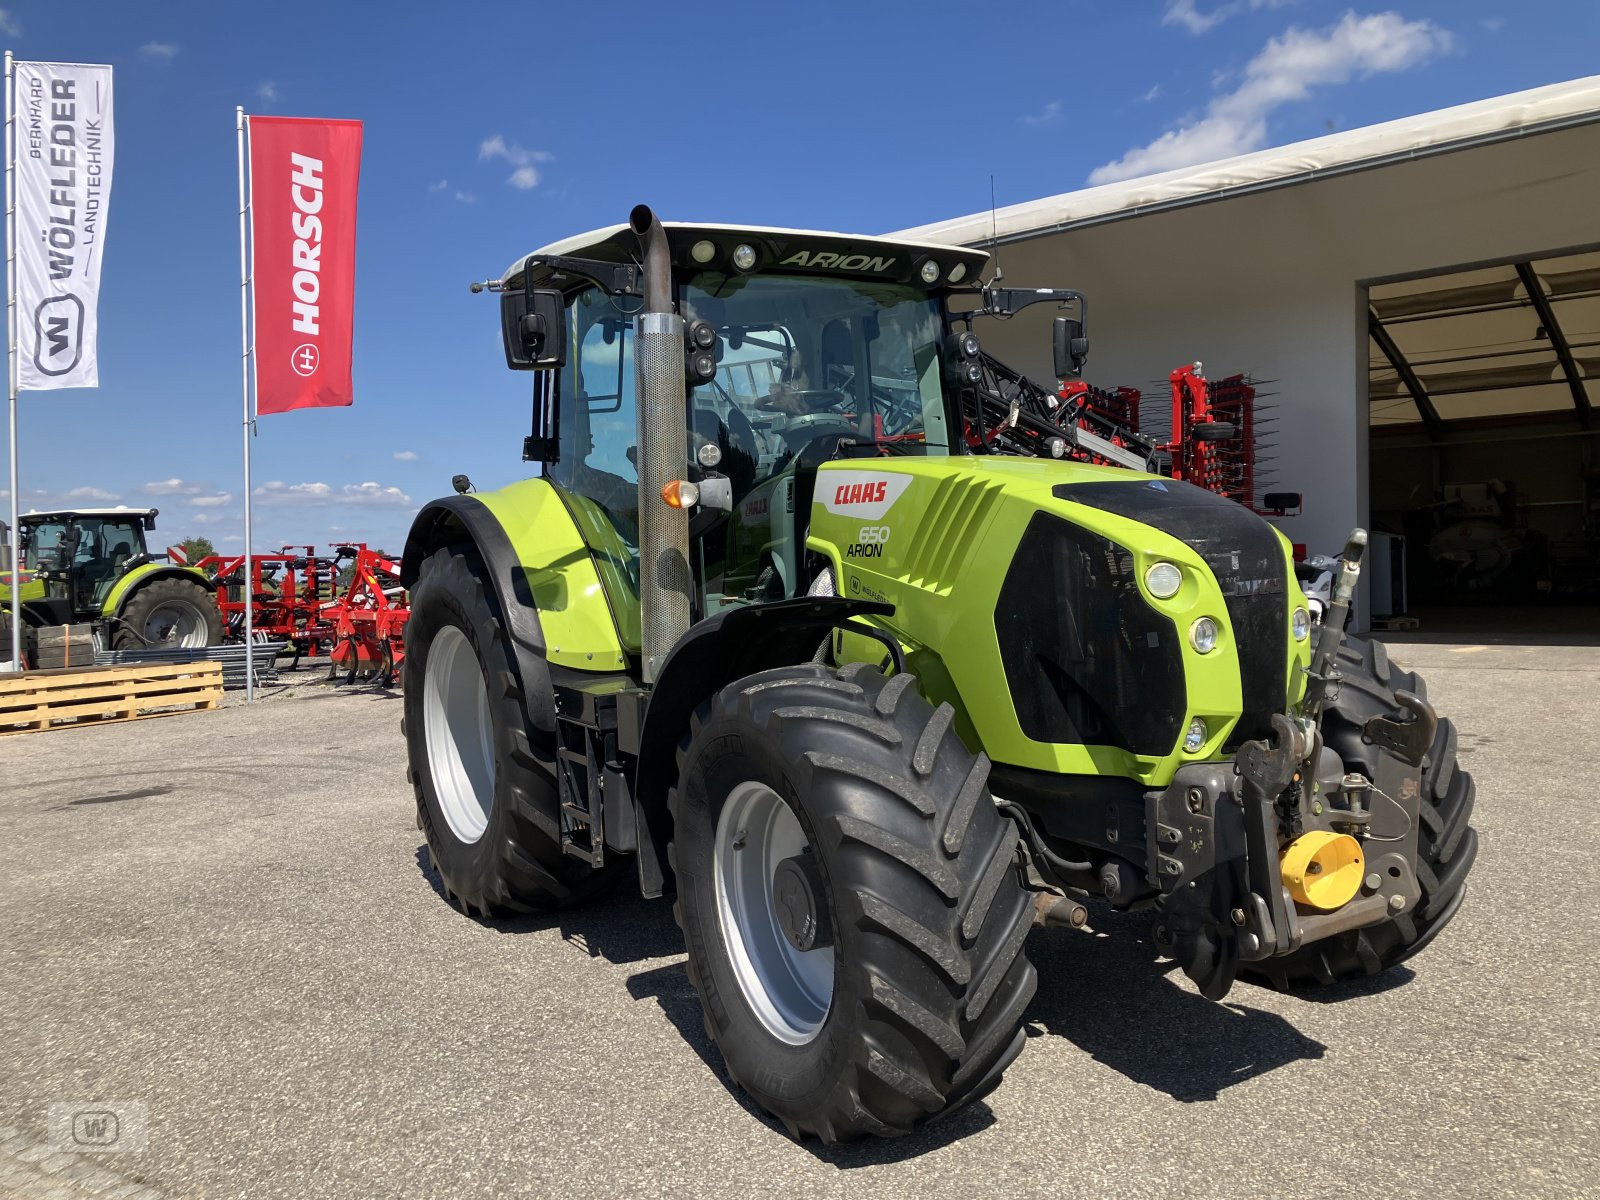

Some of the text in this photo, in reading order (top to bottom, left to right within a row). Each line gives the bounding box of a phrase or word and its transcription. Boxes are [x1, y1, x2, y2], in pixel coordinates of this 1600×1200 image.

[29, 77, 42, 159] BERNHARD
[41, 79, 76, 281] WÖLFLEDER
[83, 118, 101, 245] LANDTECHNIK
[291, 151, 323, 336] HORSCH
[779, 251, 896, 272] ARION
[834, 481, 888, 505] CLAAS
[846, 543, 883, 558] ARION
[858, 525, 891, 544] 650
